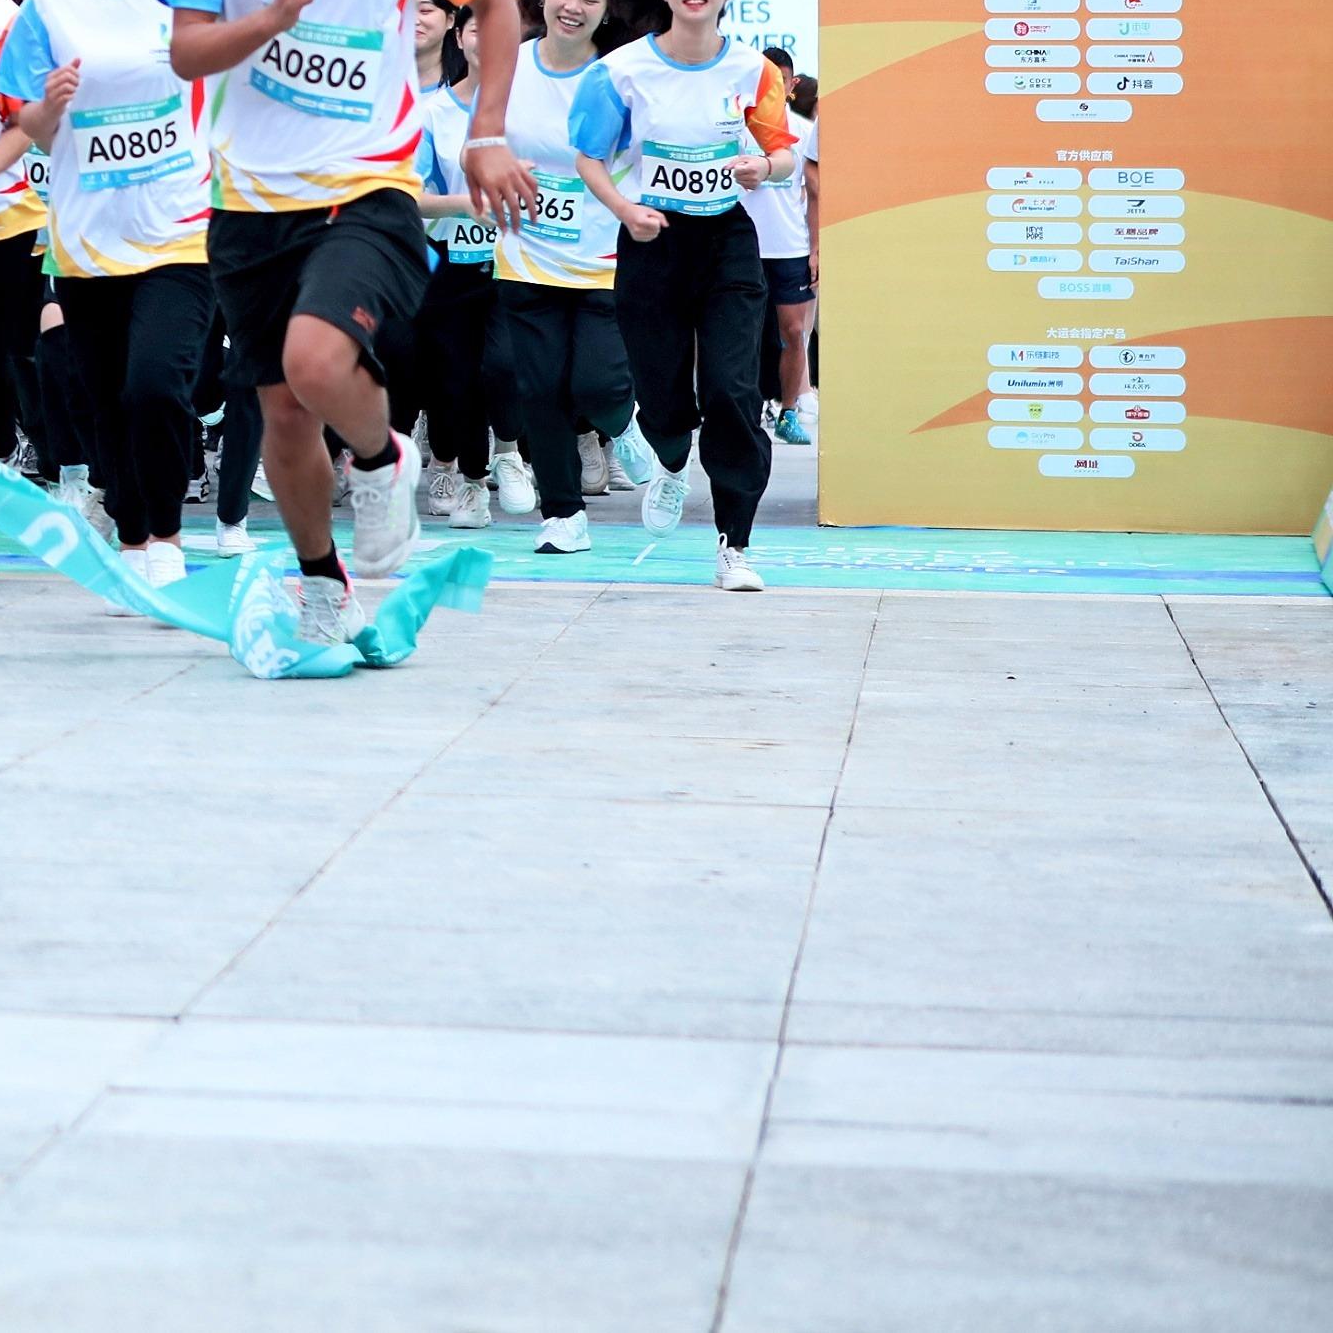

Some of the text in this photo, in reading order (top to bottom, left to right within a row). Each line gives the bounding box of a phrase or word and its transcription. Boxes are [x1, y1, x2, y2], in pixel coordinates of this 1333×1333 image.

[262, 39, 366, 91] A0806
[1132, 79, 1154, 89] 抖音
[88, 120, 178, 163] A0805
[1055, 149, 1114, 162] 官方供应商
[650, 164, 733, 195] A0898
[1117, 171, 1155, 184] BOE
[1113, 256, 1160, 266] TaiShan
[1059, 283, 1090, 293] BOSS
[1007, 379, 1047, 388] Unilumin
